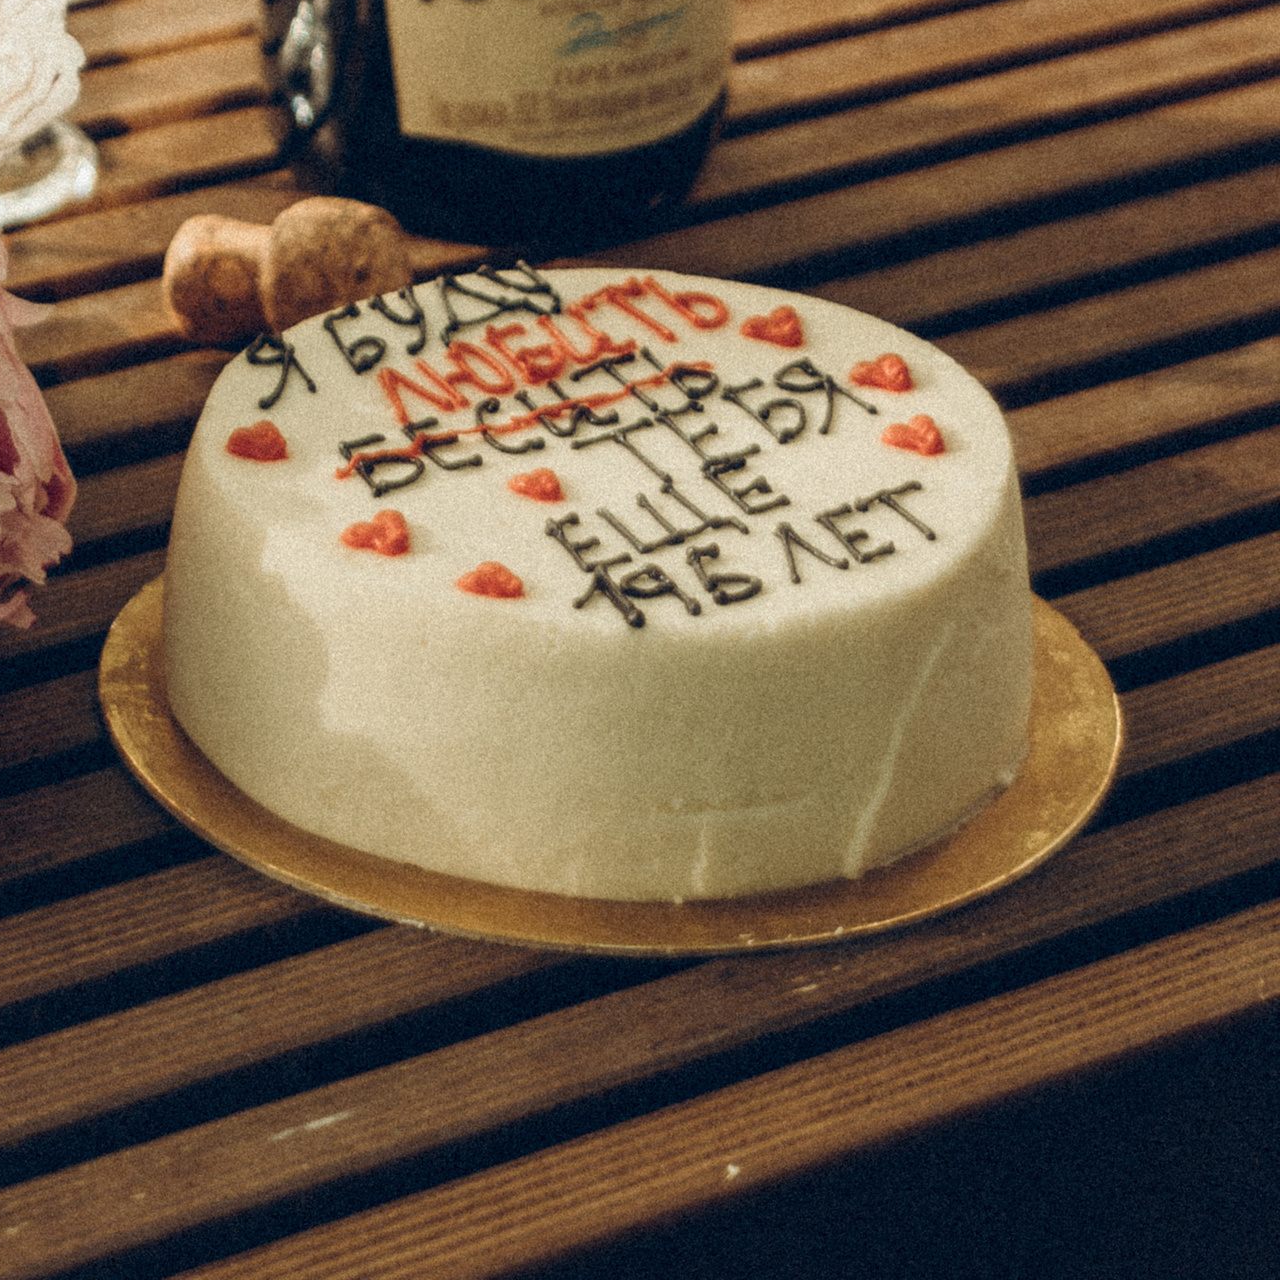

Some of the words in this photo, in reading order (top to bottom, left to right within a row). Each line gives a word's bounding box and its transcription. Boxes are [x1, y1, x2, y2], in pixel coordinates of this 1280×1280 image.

[246, 332, 318, 410] Я
[323, 260, 561, 374] БУДУ
[377, 276, 730, 424] ЛЮБИТЬ
[337, 346, 719, 498] БЕСИТЬ
[571, 357, 879, 485] ТЕБЯ
[775, 481, 937, 584] ЛЕТ
